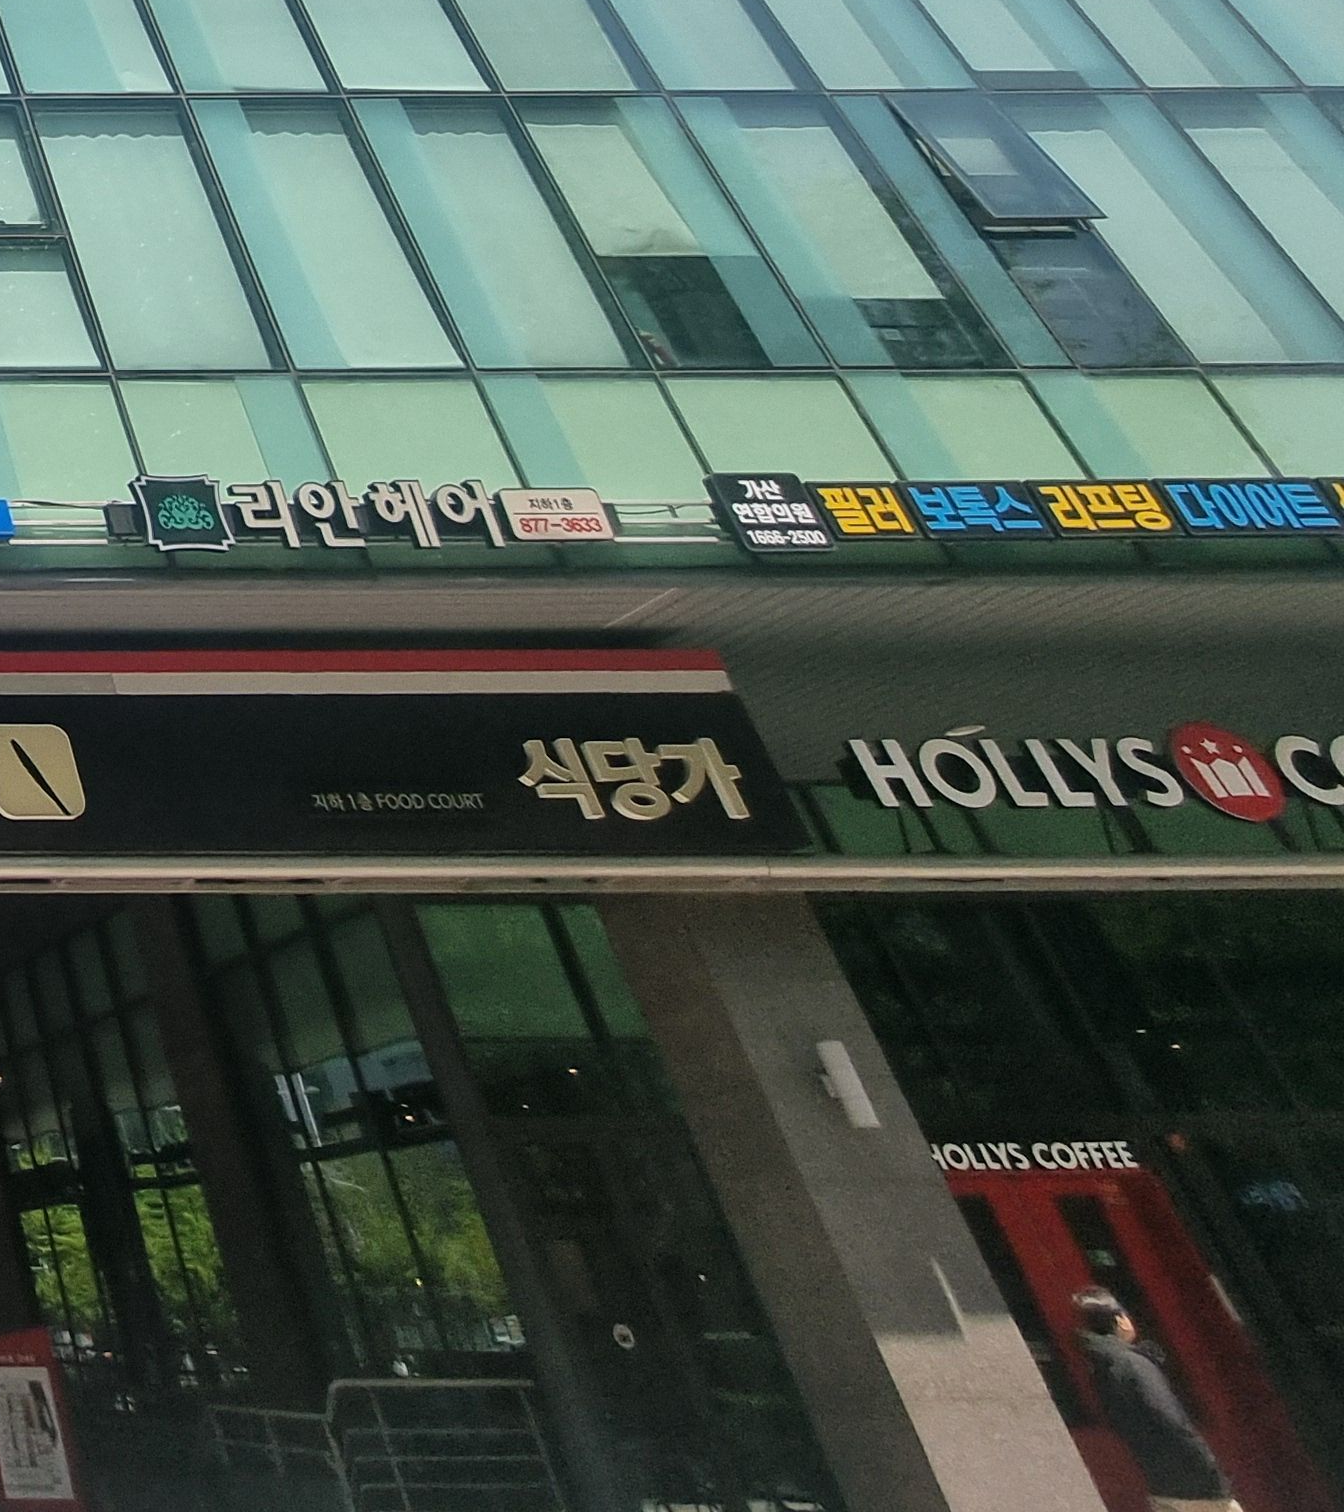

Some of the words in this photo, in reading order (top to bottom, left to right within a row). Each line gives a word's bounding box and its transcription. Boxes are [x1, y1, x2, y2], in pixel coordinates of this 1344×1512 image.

[738, 479, 784, 500] 가산
[228, 479, 506, 549] 리안헤어
[732, 502, 817, 524] 연합의원
[816, 487, 915, 534] 필러
[907, 486, 1044, 532] 보톡스
[1039, 484, 1172, 531] 리프팅
[1164, 482, 1341, 529] 다이어트
[519, 517, 603, 533] 877-3633
[746, 529, 828, 544] 1666-2500
[518, 737, 750, 820] 식당가
[848, 734, 1184, 809] HOLLYS
[1274, 735, 1344, 806] C
[375, 793, 424, 810] FOOD
[428, 793, 485, 810] COURT
[1031, 1141, 1139, 1171] COFFEE
